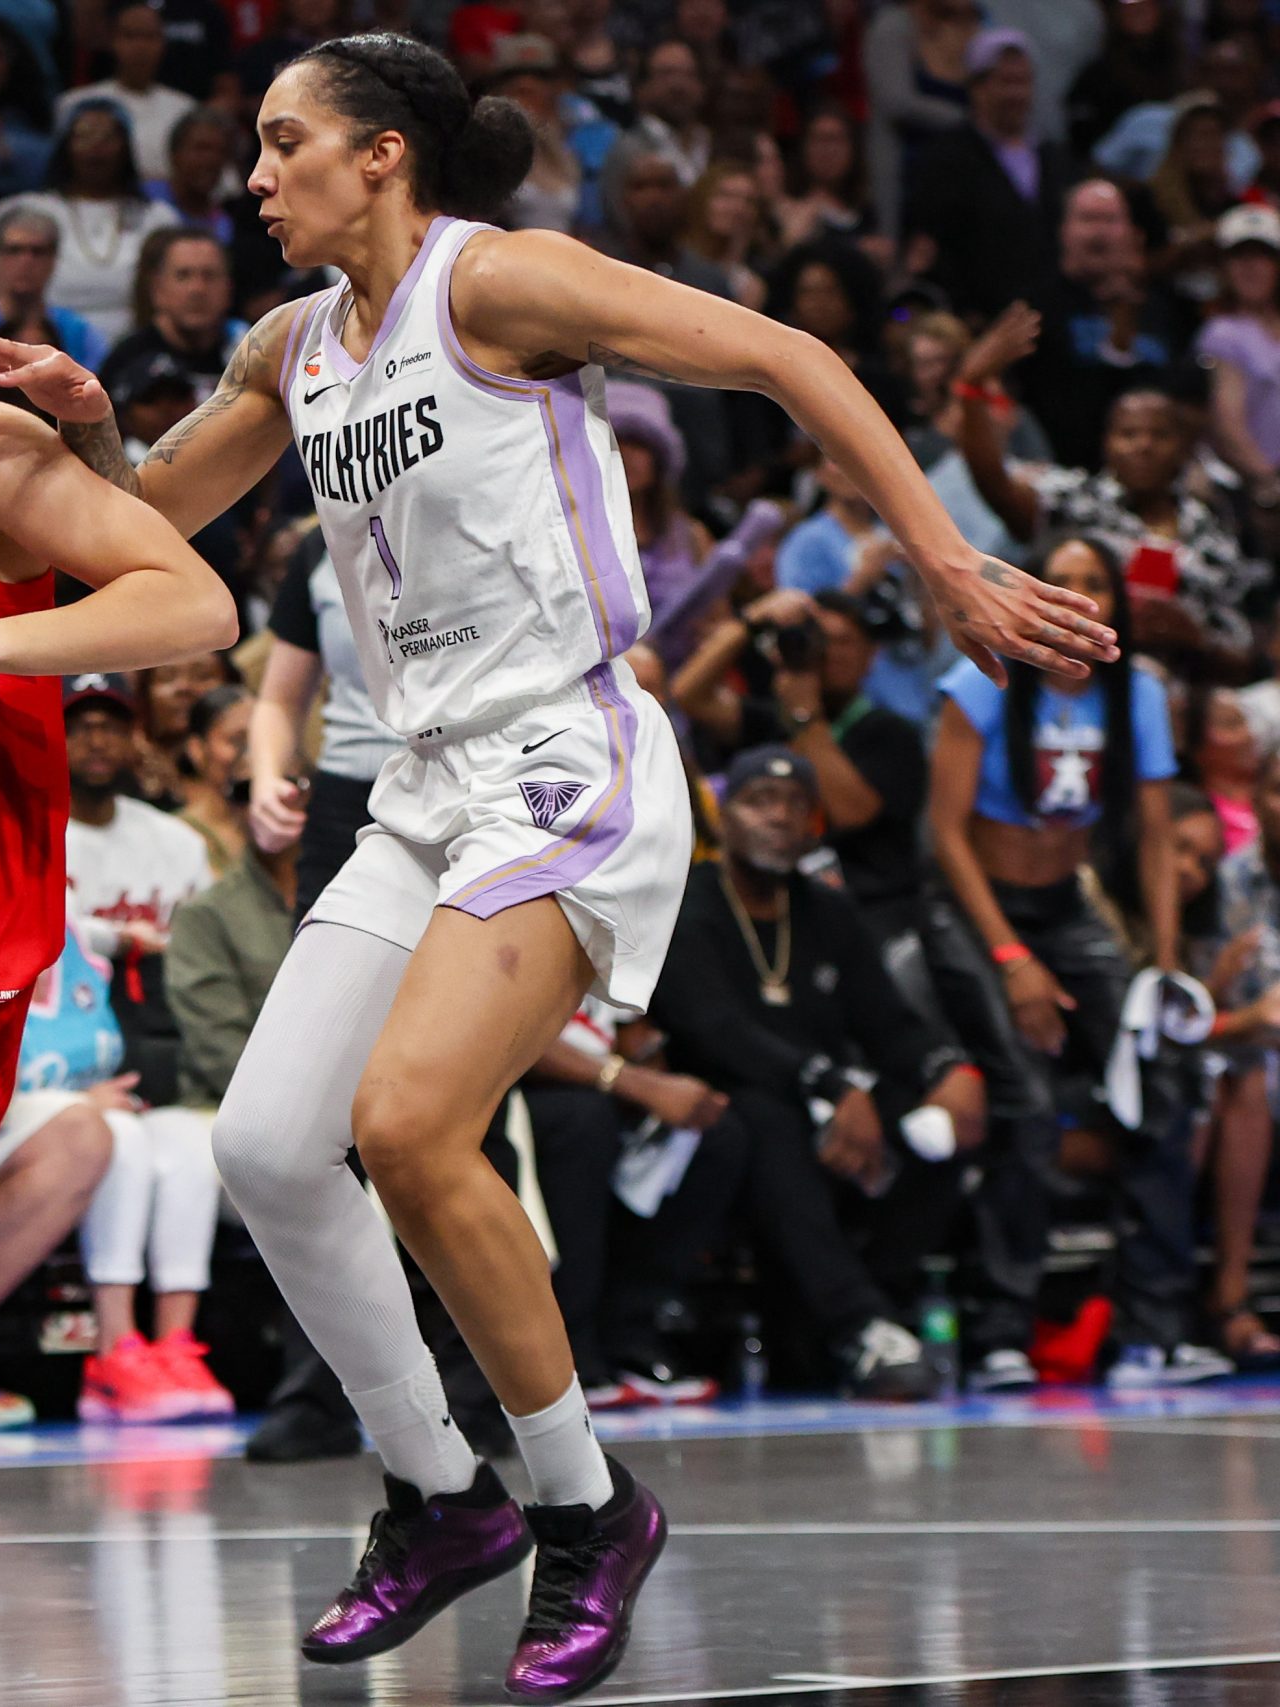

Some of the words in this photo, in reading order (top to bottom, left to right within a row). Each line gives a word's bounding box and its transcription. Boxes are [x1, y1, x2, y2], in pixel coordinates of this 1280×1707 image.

[399, 351, 431, 373] freedom
[370, 515, 402, 600] 1
[391, 618, 431, 641] KAISER
[399, 625, 480, 658] PERMANENTE
